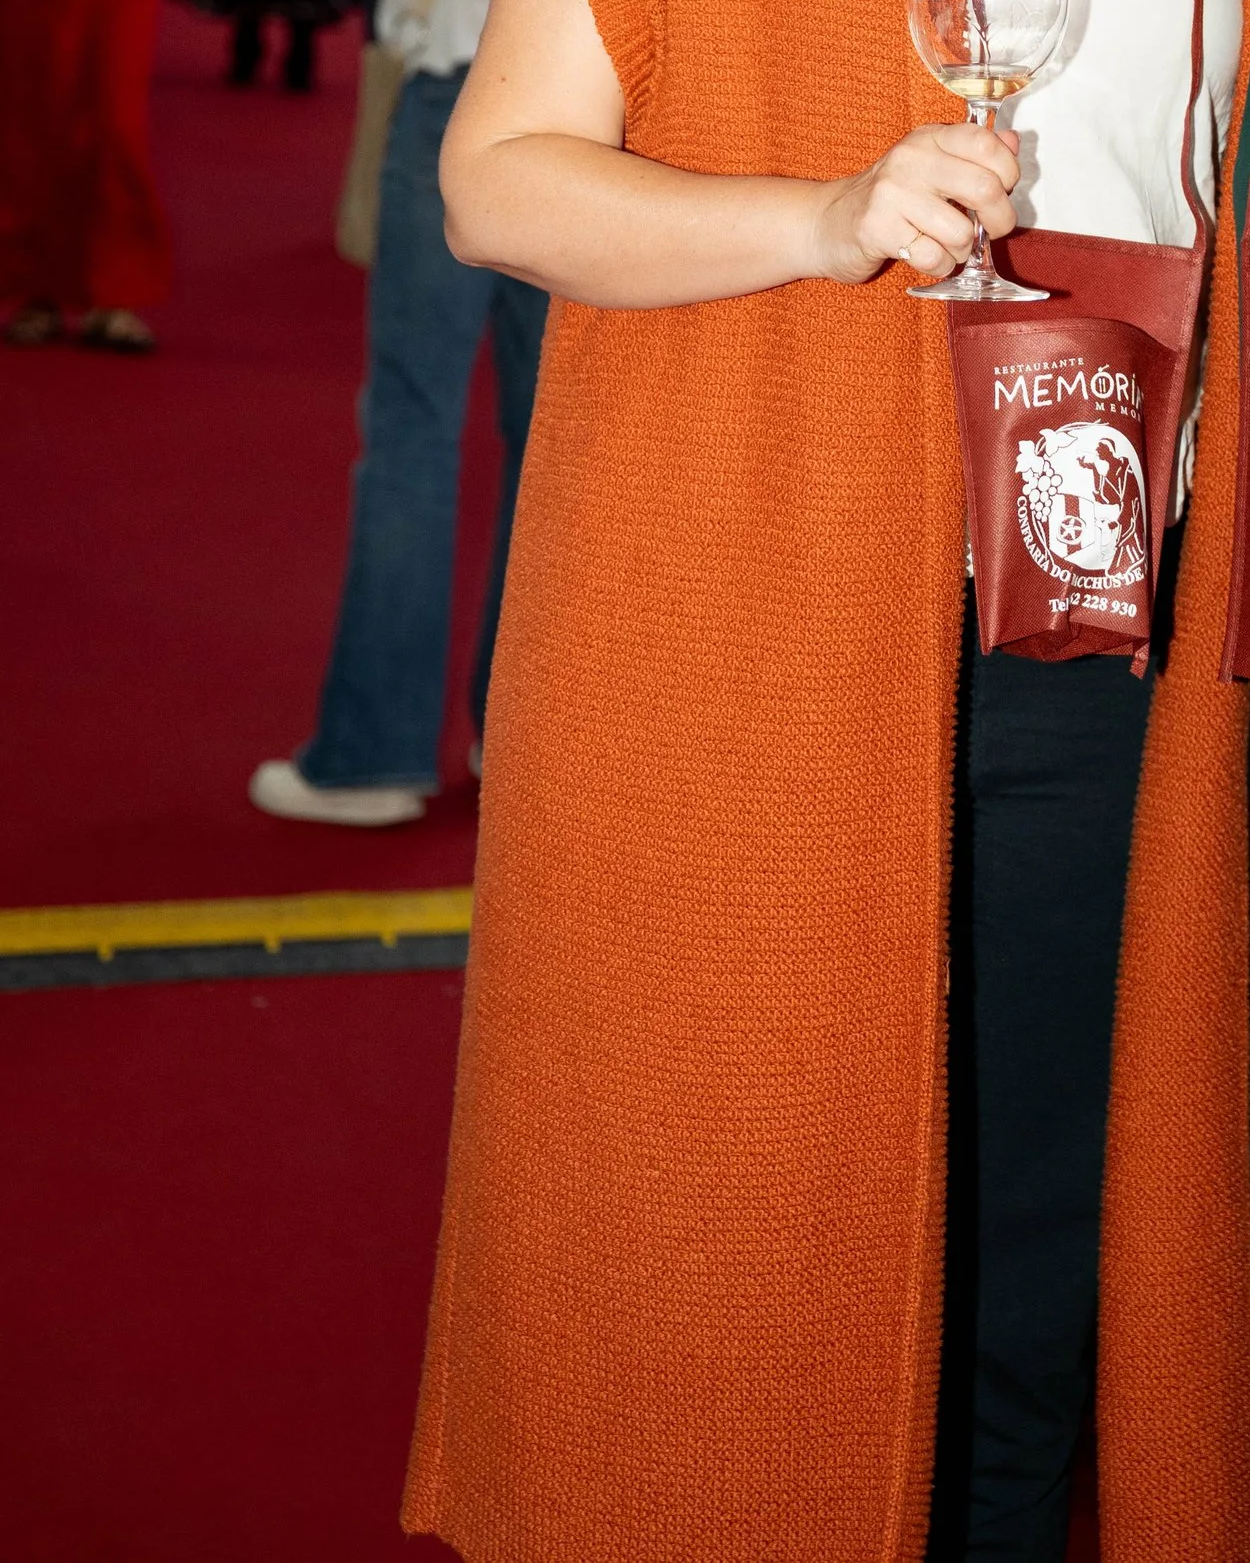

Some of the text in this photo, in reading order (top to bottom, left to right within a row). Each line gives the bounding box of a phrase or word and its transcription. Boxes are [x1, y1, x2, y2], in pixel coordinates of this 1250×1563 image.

[994, 357, 1085, 375] RESTAURANTE
[1095, 401, 1141, 422] MEMO
[1016, 495, 1050, 573] CONFRARIA
[1050, 565, 1072, 583] DO
[1124, 567, 1145, 586] DE
[1049, 598, 1069, 614] Tel
[1082, 594, 1108, 611] 228
[1110, 600, 1137, 618] 930
